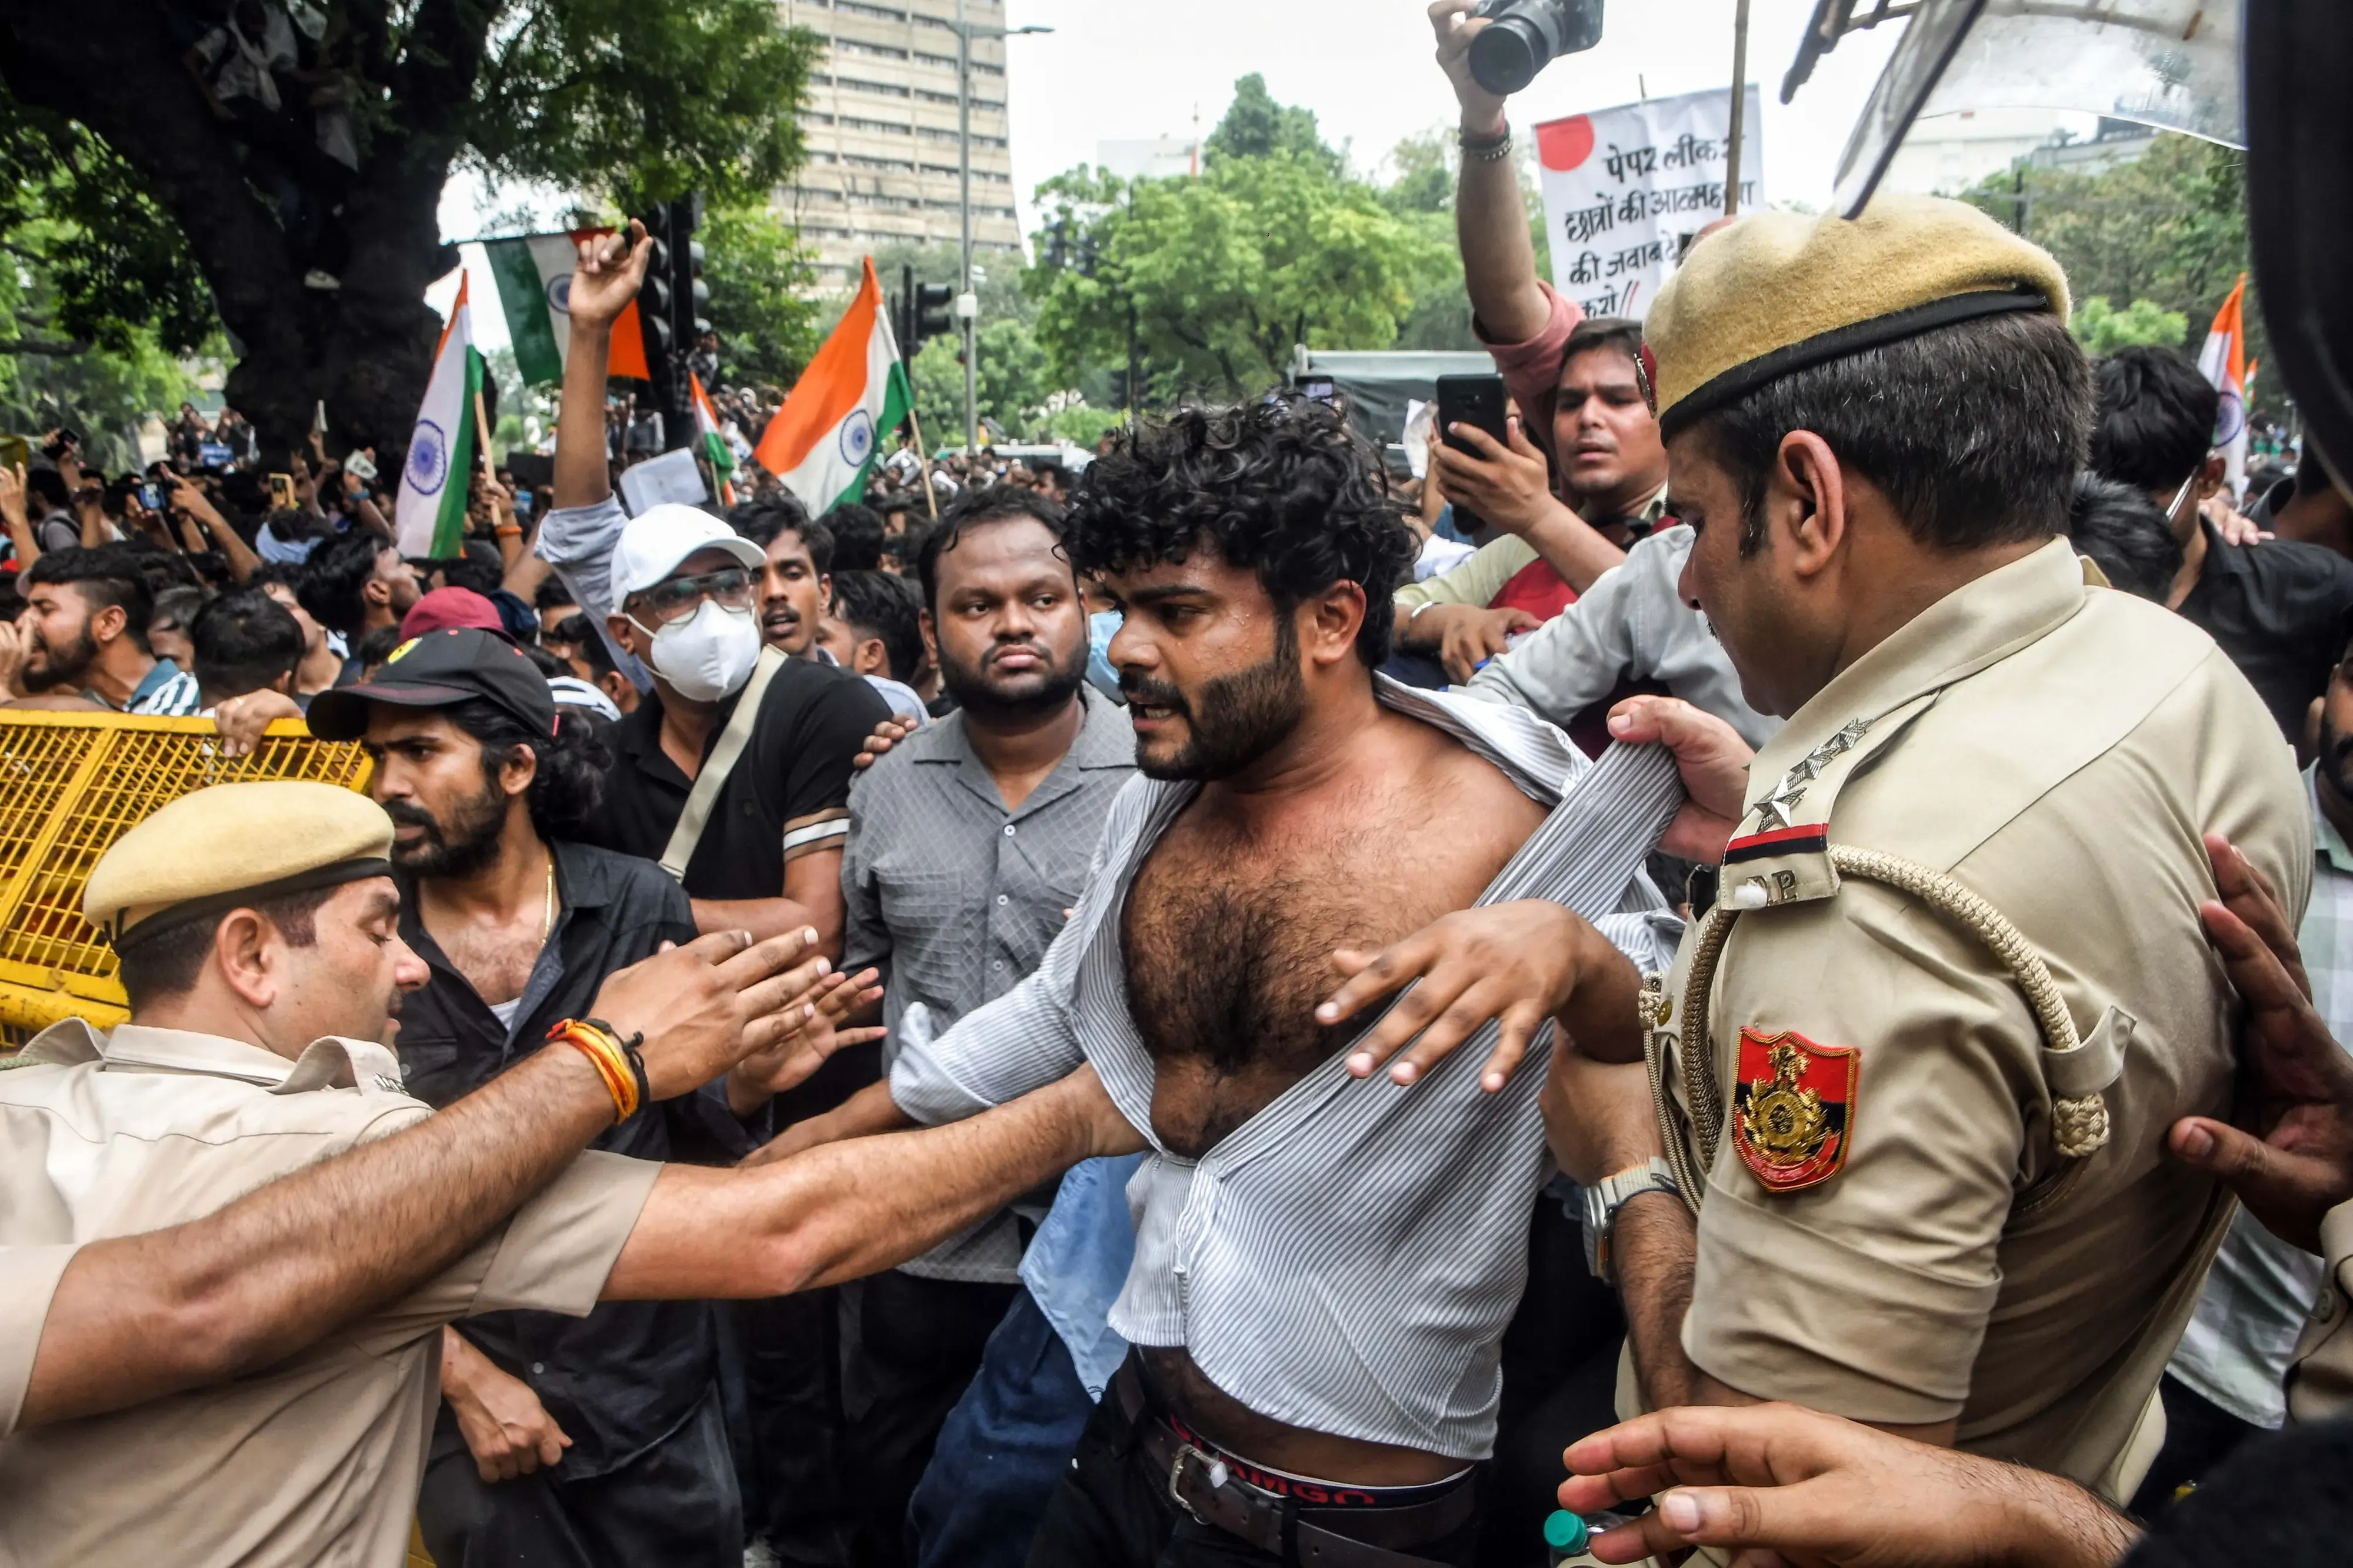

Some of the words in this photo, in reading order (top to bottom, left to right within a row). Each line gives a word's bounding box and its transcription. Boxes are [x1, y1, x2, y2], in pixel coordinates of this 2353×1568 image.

[1602, 142, 1658, 183] पेपर
[1664, 133, 1717, 168] लीक
[1565, 191, 1614, 242] छात्रों
[1618, 189, 1647, 224] की
[1570, 251, 1601, 283] की
